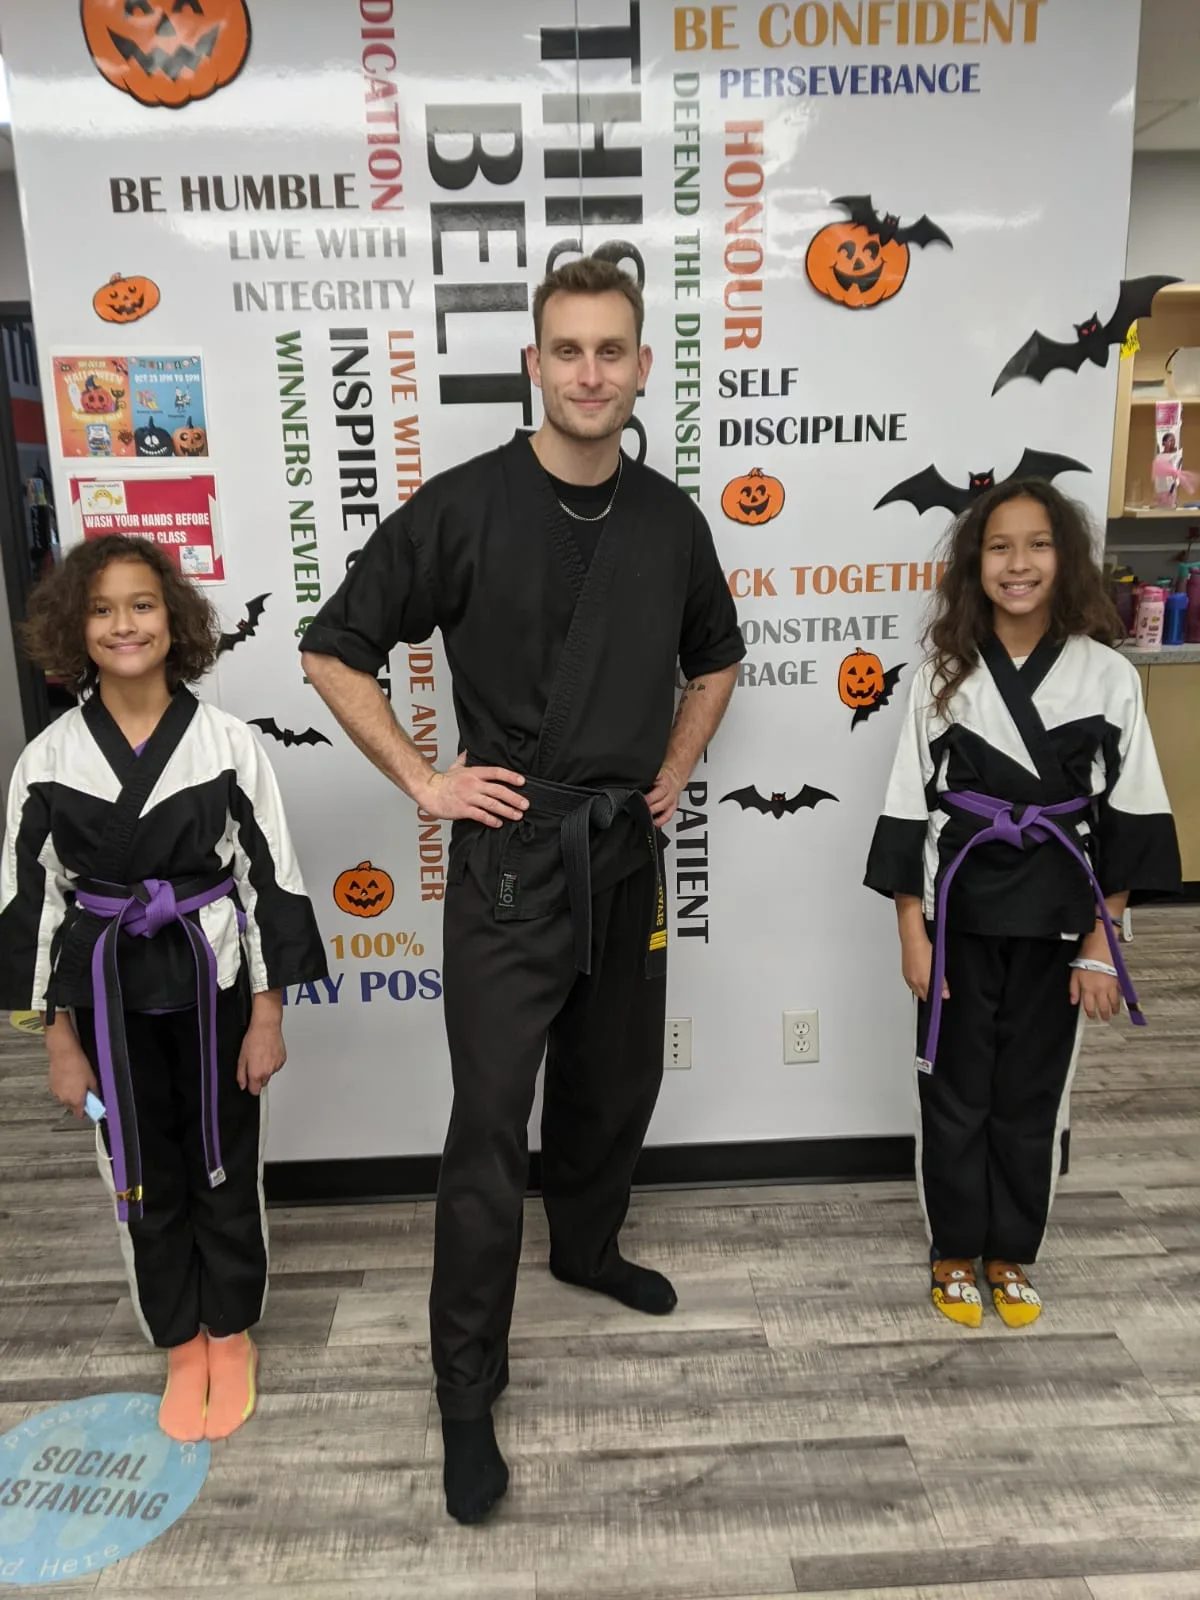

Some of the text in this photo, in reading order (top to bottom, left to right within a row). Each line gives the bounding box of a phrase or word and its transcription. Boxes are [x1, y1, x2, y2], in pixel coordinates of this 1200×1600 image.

[673, 0, 1048, 51] BE CONFIDENT
[719, 63, 981, 99] PERSEVERANCE
[359, 0, 405, 212] DICATION
[109, 172, 360, 213] BE HUMBLE
[228, 227, 407, 260] LIVE WITH
[724, 120, 765, 351] HONOUR
[424, 103, 534, 427] BELT
[232, 279, 415, 312] INTEGRITY
[673, 72, 702, 503] DEFEND THE DEFENSEL
[718, 367, 799, 398] SELF
[275, 329, 313, 487] WINNERS
[388, 330, 424, 501] LIVE WITH
[329, 327, 381, 532] INSPIRE
[719, 413, 908, 447] DISCIPLINE
[84, 512, 210, 528] WASH YOUR HANDS BEFORE
[157, 531, 188, 544] CLASS
[289, 500, 322, 604] NEVER
[789, 559, 952, 597] TOGETH
[739, 614, 900, 646] ONSTRATE
[736, 659, 819, 688] RAGE
[675, 780, 709, 944] PATIENT
[329, 931, 425, 960] 100%
[32, 1445, 148, 1482] SOCIAL
[0, 1476, 170, 1521] ISTANCING
[39, 1543, 121, 1579] Here
